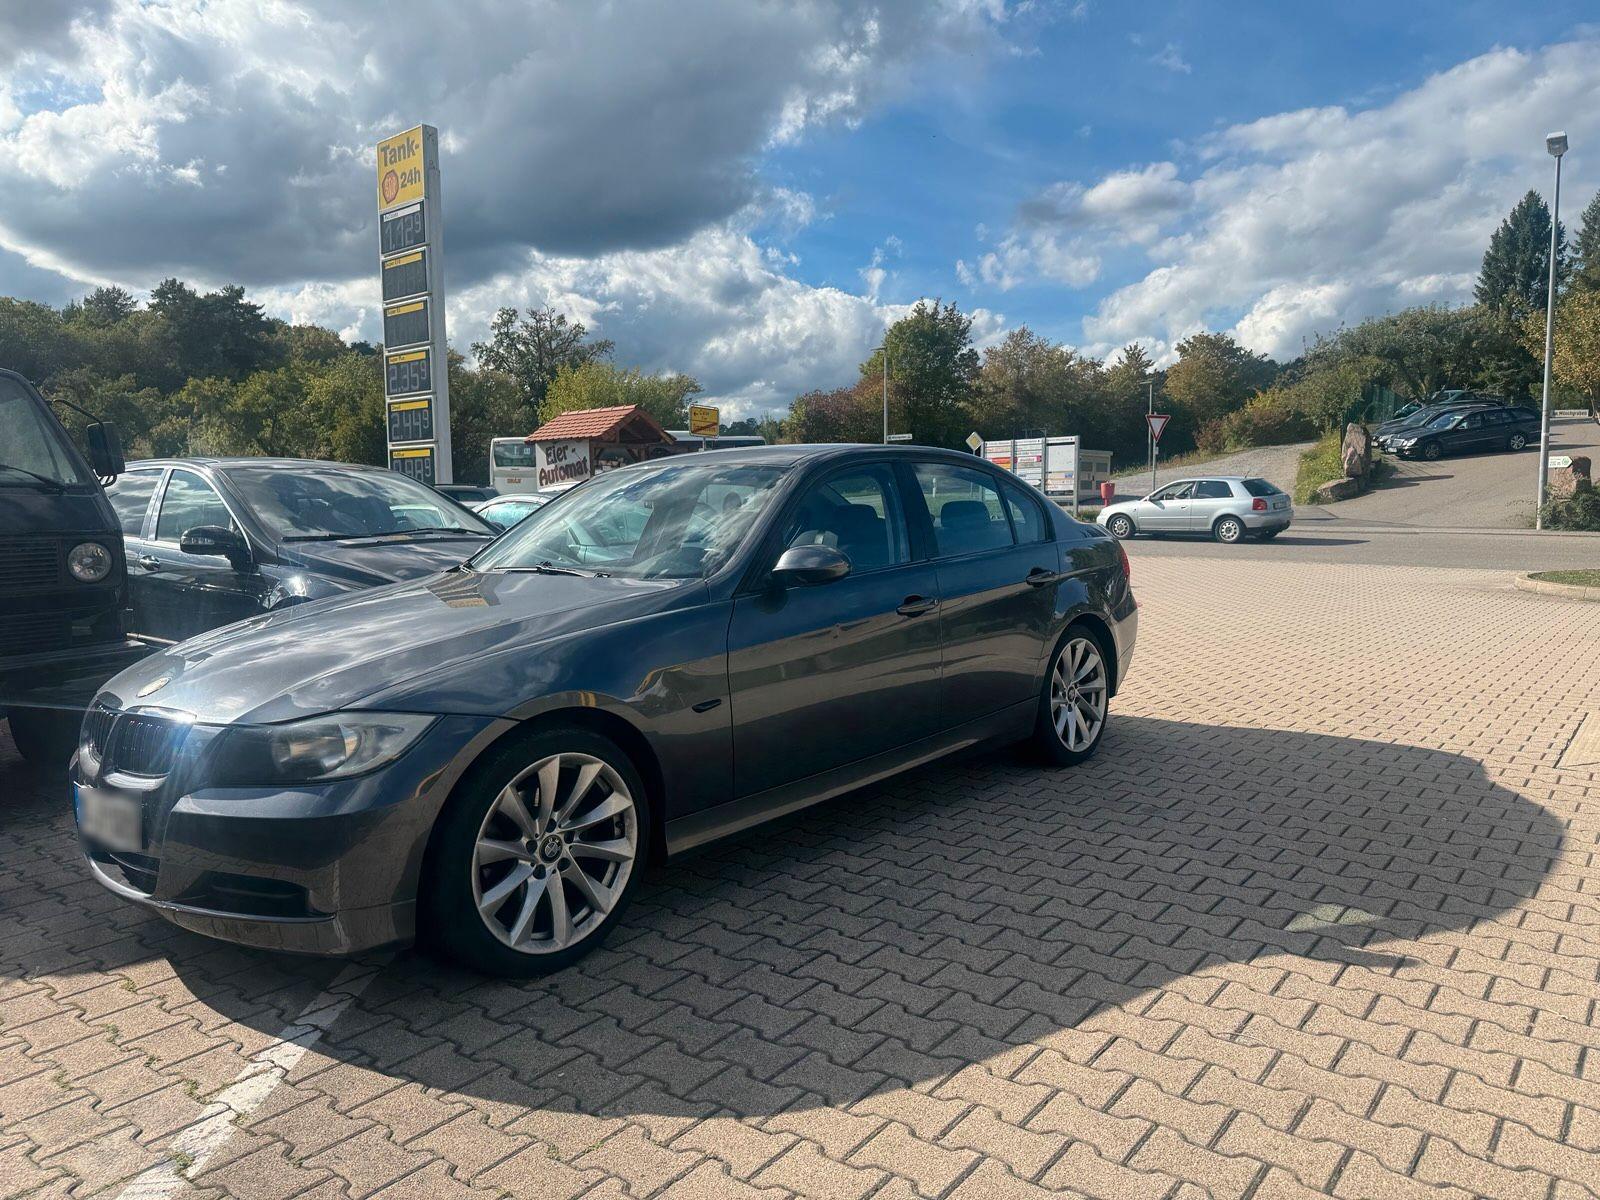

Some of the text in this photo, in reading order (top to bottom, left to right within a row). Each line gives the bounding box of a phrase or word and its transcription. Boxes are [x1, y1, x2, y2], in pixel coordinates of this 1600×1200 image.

[380, 136, 419, 167] Tank-
[400, 166, 421, 189] 24h
[546, 444, 568, 466] Eier
[539, 456, 589, 487] Automat
